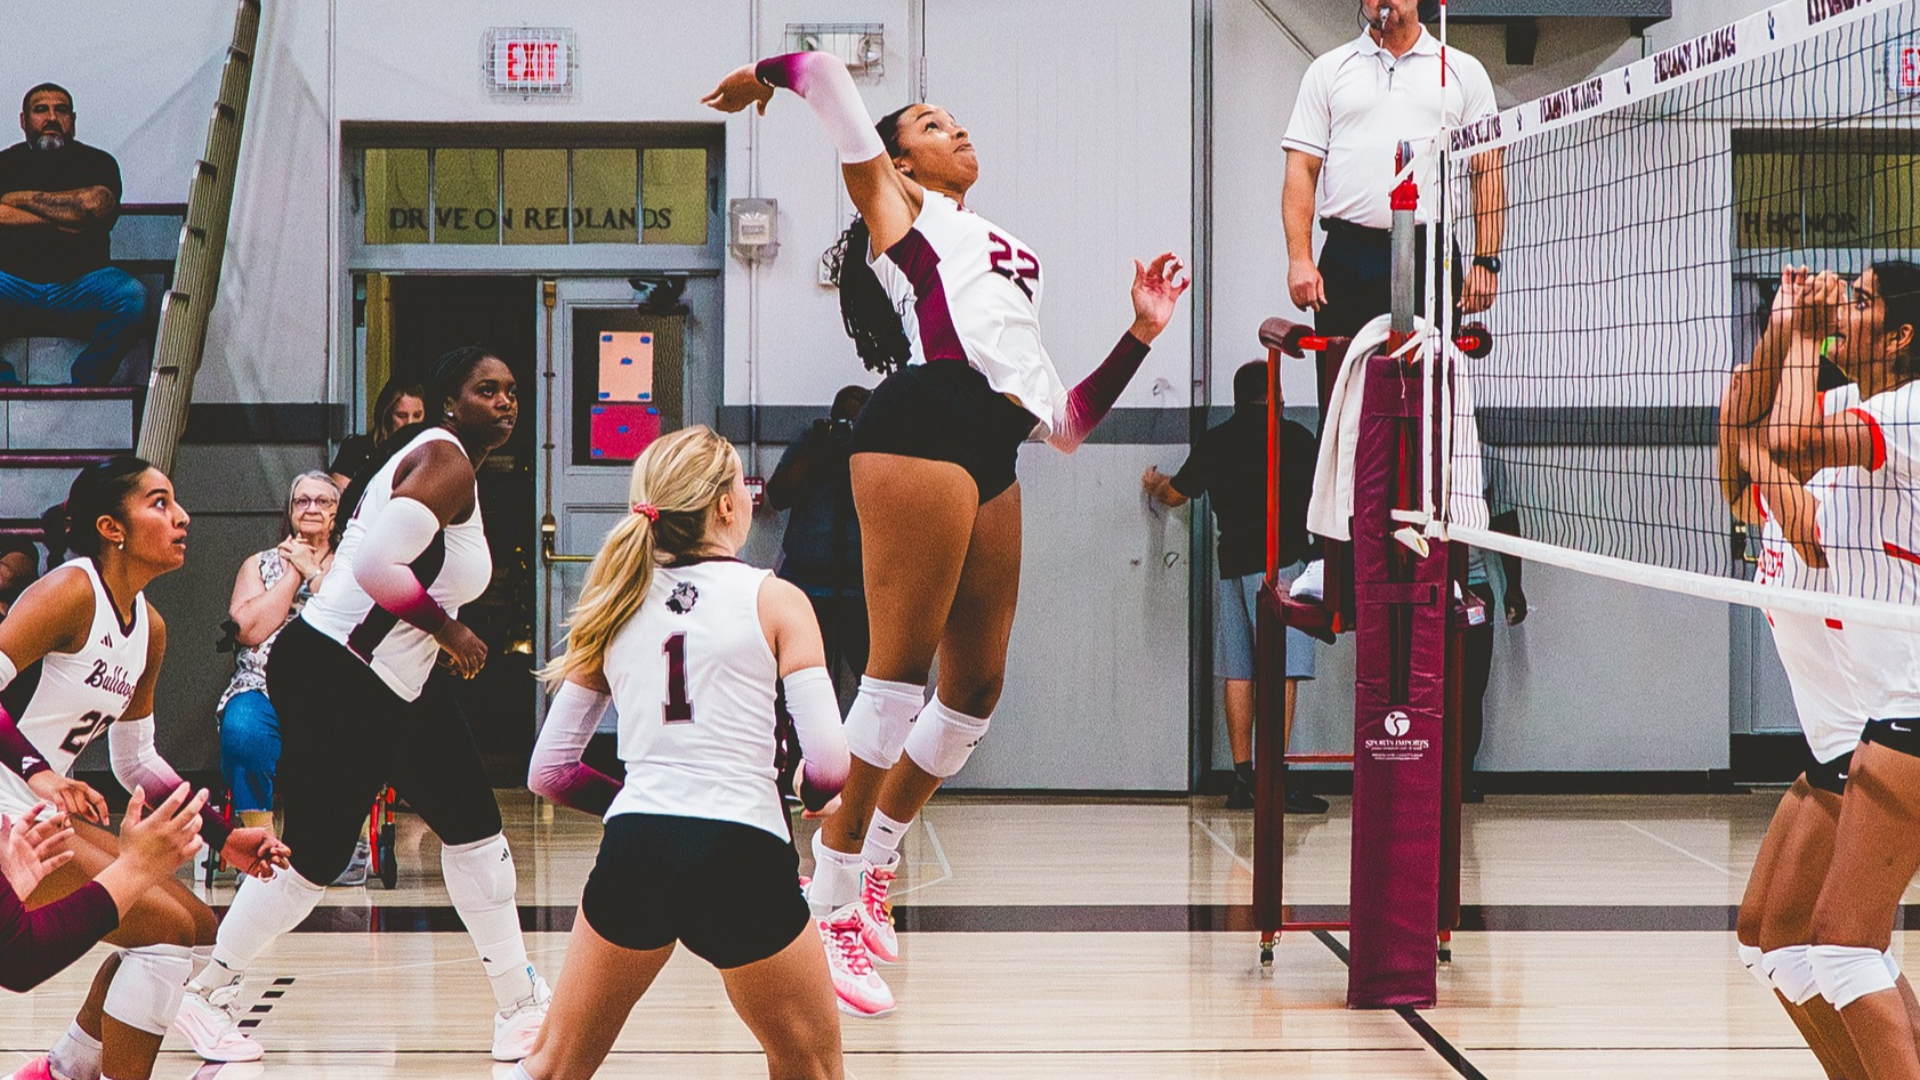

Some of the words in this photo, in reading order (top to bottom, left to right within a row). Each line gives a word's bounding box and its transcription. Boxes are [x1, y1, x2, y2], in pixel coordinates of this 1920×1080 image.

[507, 43, 558, 81] EXIT
[1902, 48, 1920, 86] E
[389, 207, 468, 230] DRVE
[524, 207, 671, 230] REDLANDS
[988, 231, 1039, 303] 22
[661, 631, 694, 725] 1
